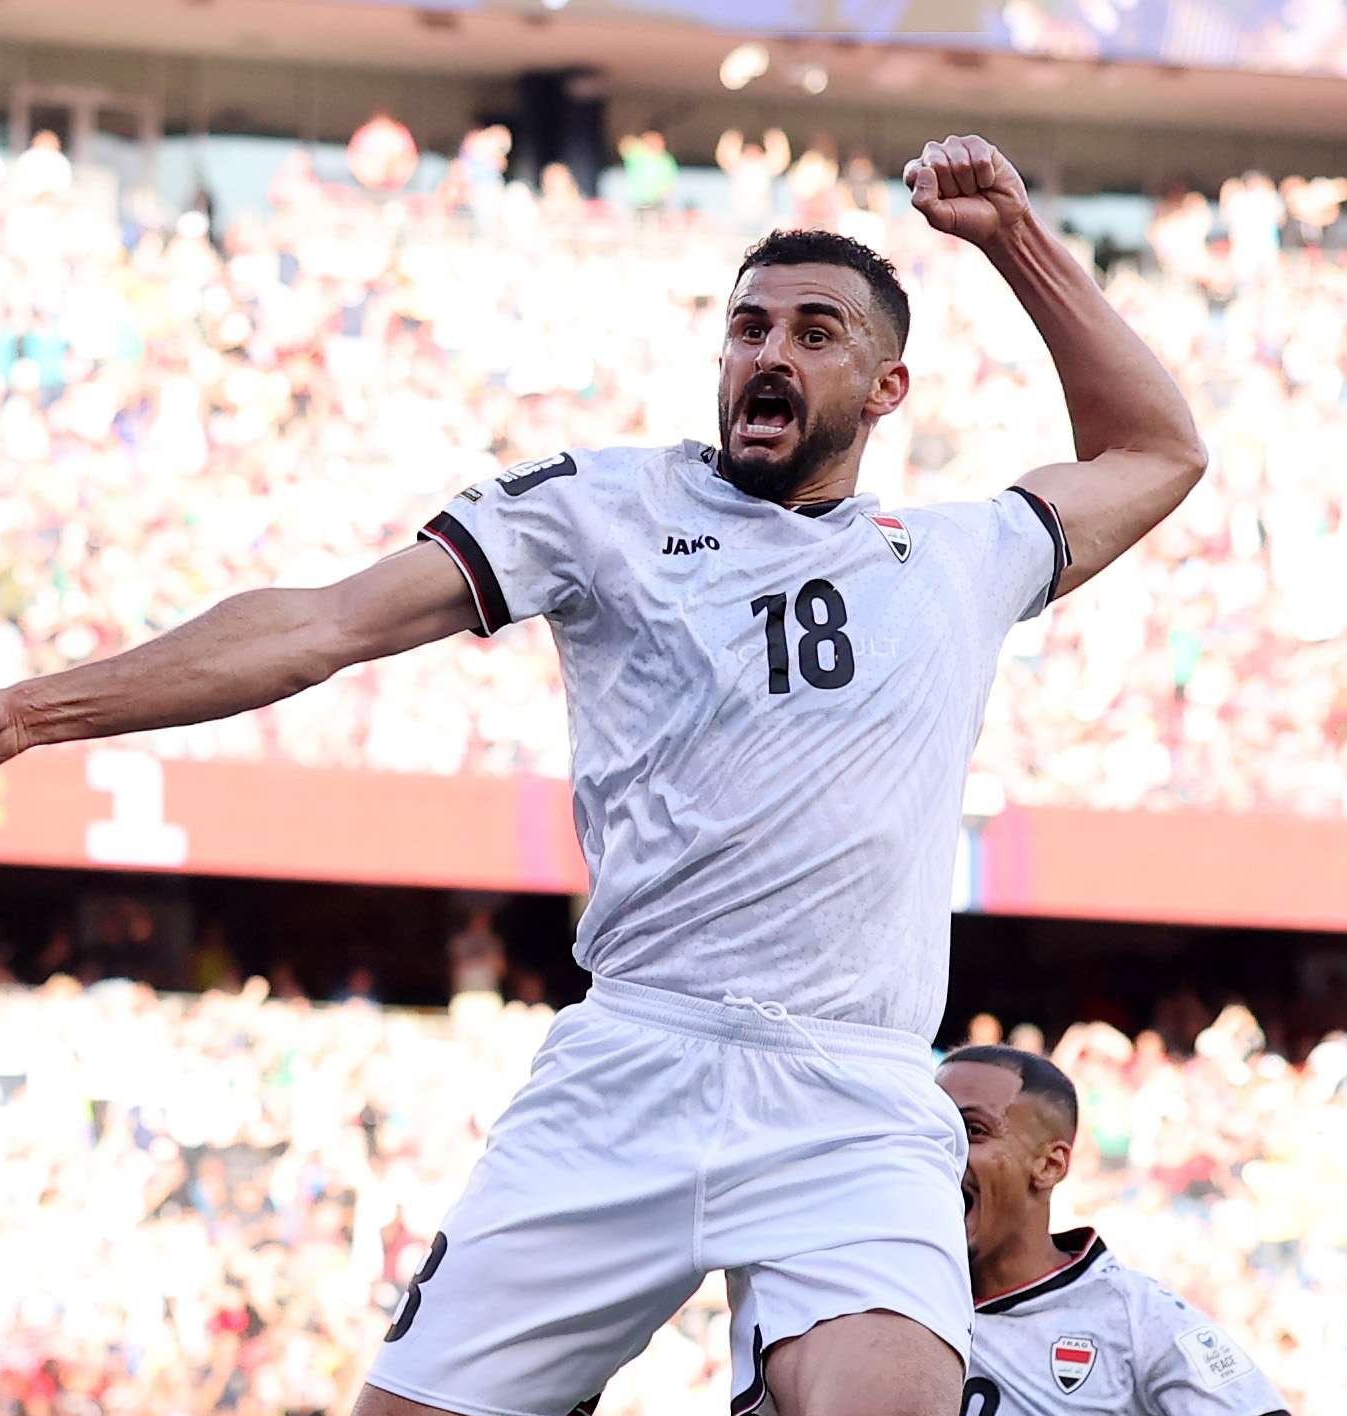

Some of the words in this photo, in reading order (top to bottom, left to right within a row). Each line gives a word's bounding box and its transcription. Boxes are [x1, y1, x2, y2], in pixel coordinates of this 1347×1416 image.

[662, 535, 721, 555] JAKO
[750, 578, 855, 695] 18
[85, 748, 189, 867] 1
